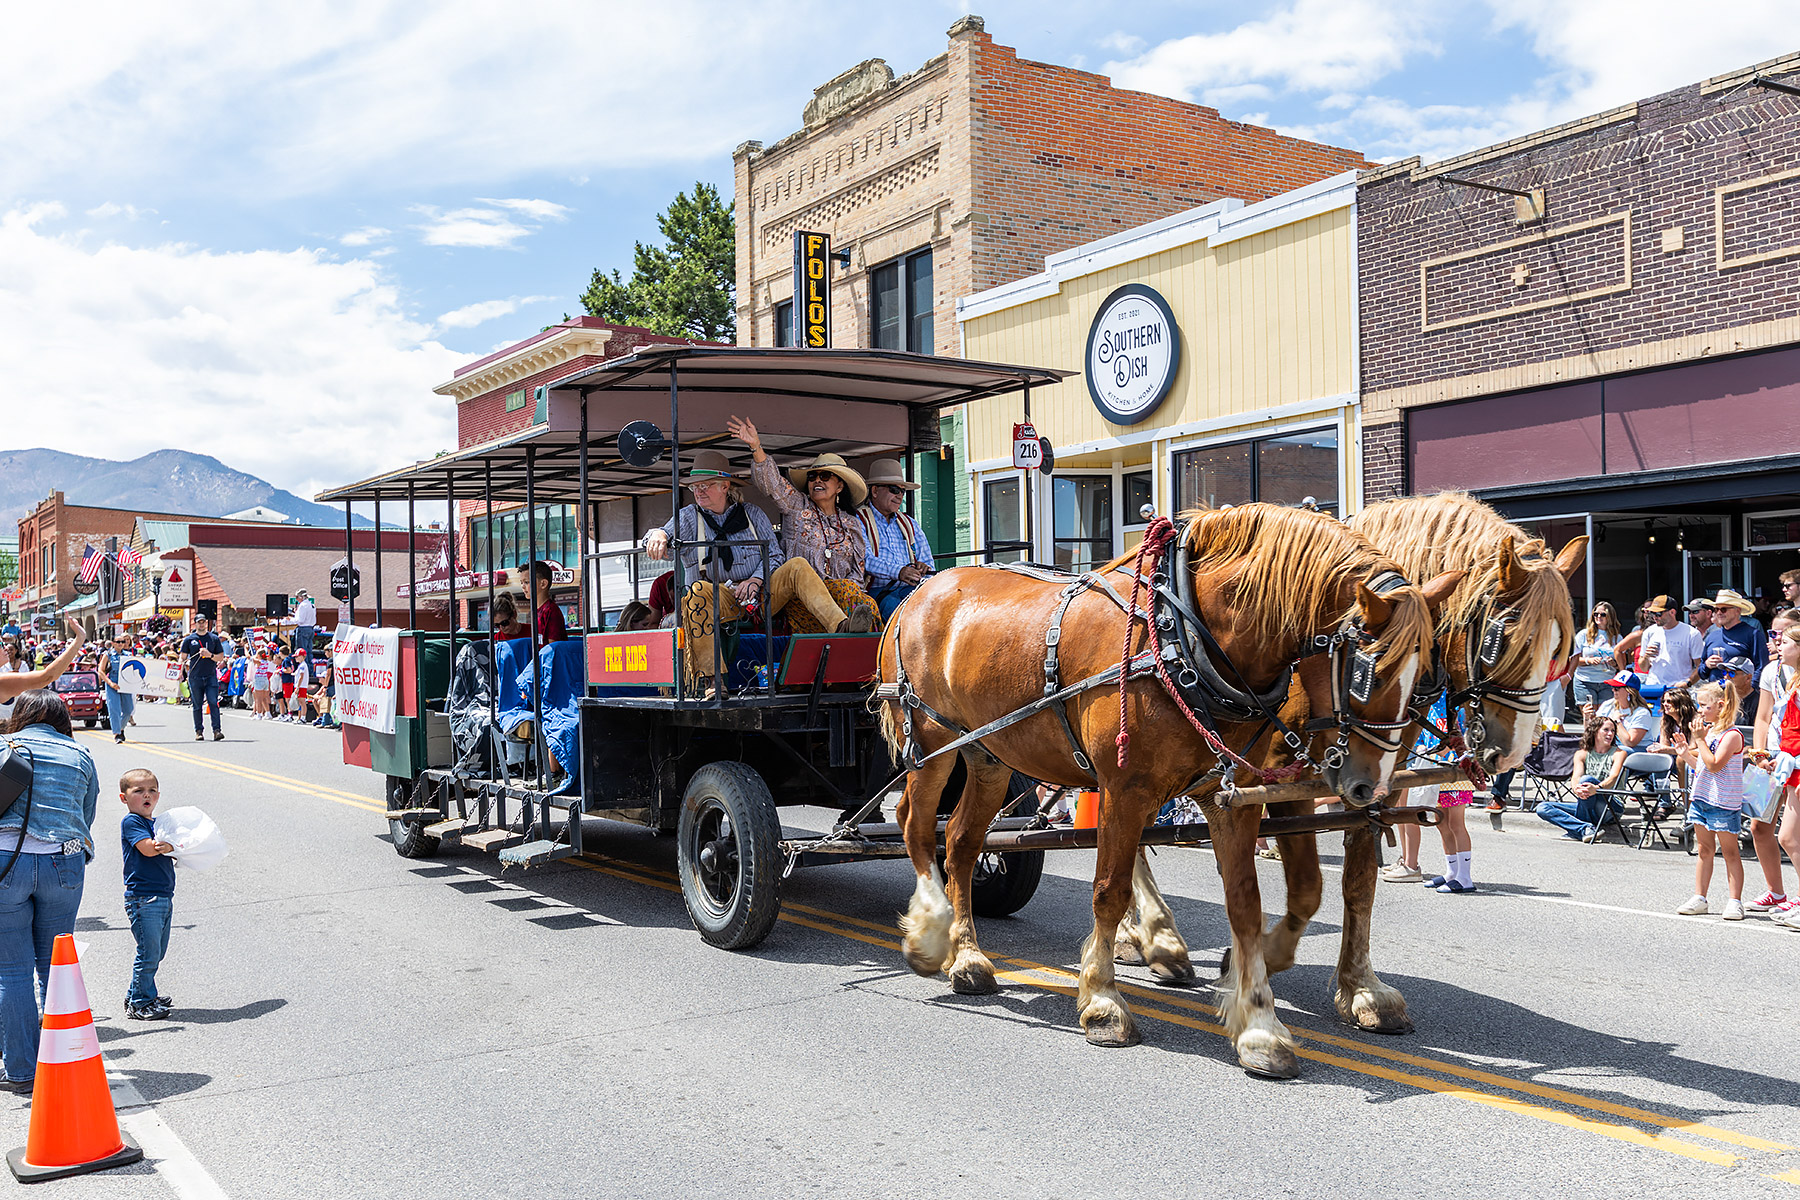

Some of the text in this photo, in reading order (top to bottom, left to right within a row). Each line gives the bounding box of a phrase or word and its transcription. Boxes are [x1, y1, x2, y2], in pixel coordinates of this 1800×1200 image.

[807, 235, 825, 347] FOLOS
[1118, 309, 1140, 320] EST. 2021
[1107, 390, 1130, 406] KITCHEN
[1138, 384, 1154, 401] HOME
[1020, 443, 1037, 459] 216
[605, 645, 647, 672] FREE RIDES
